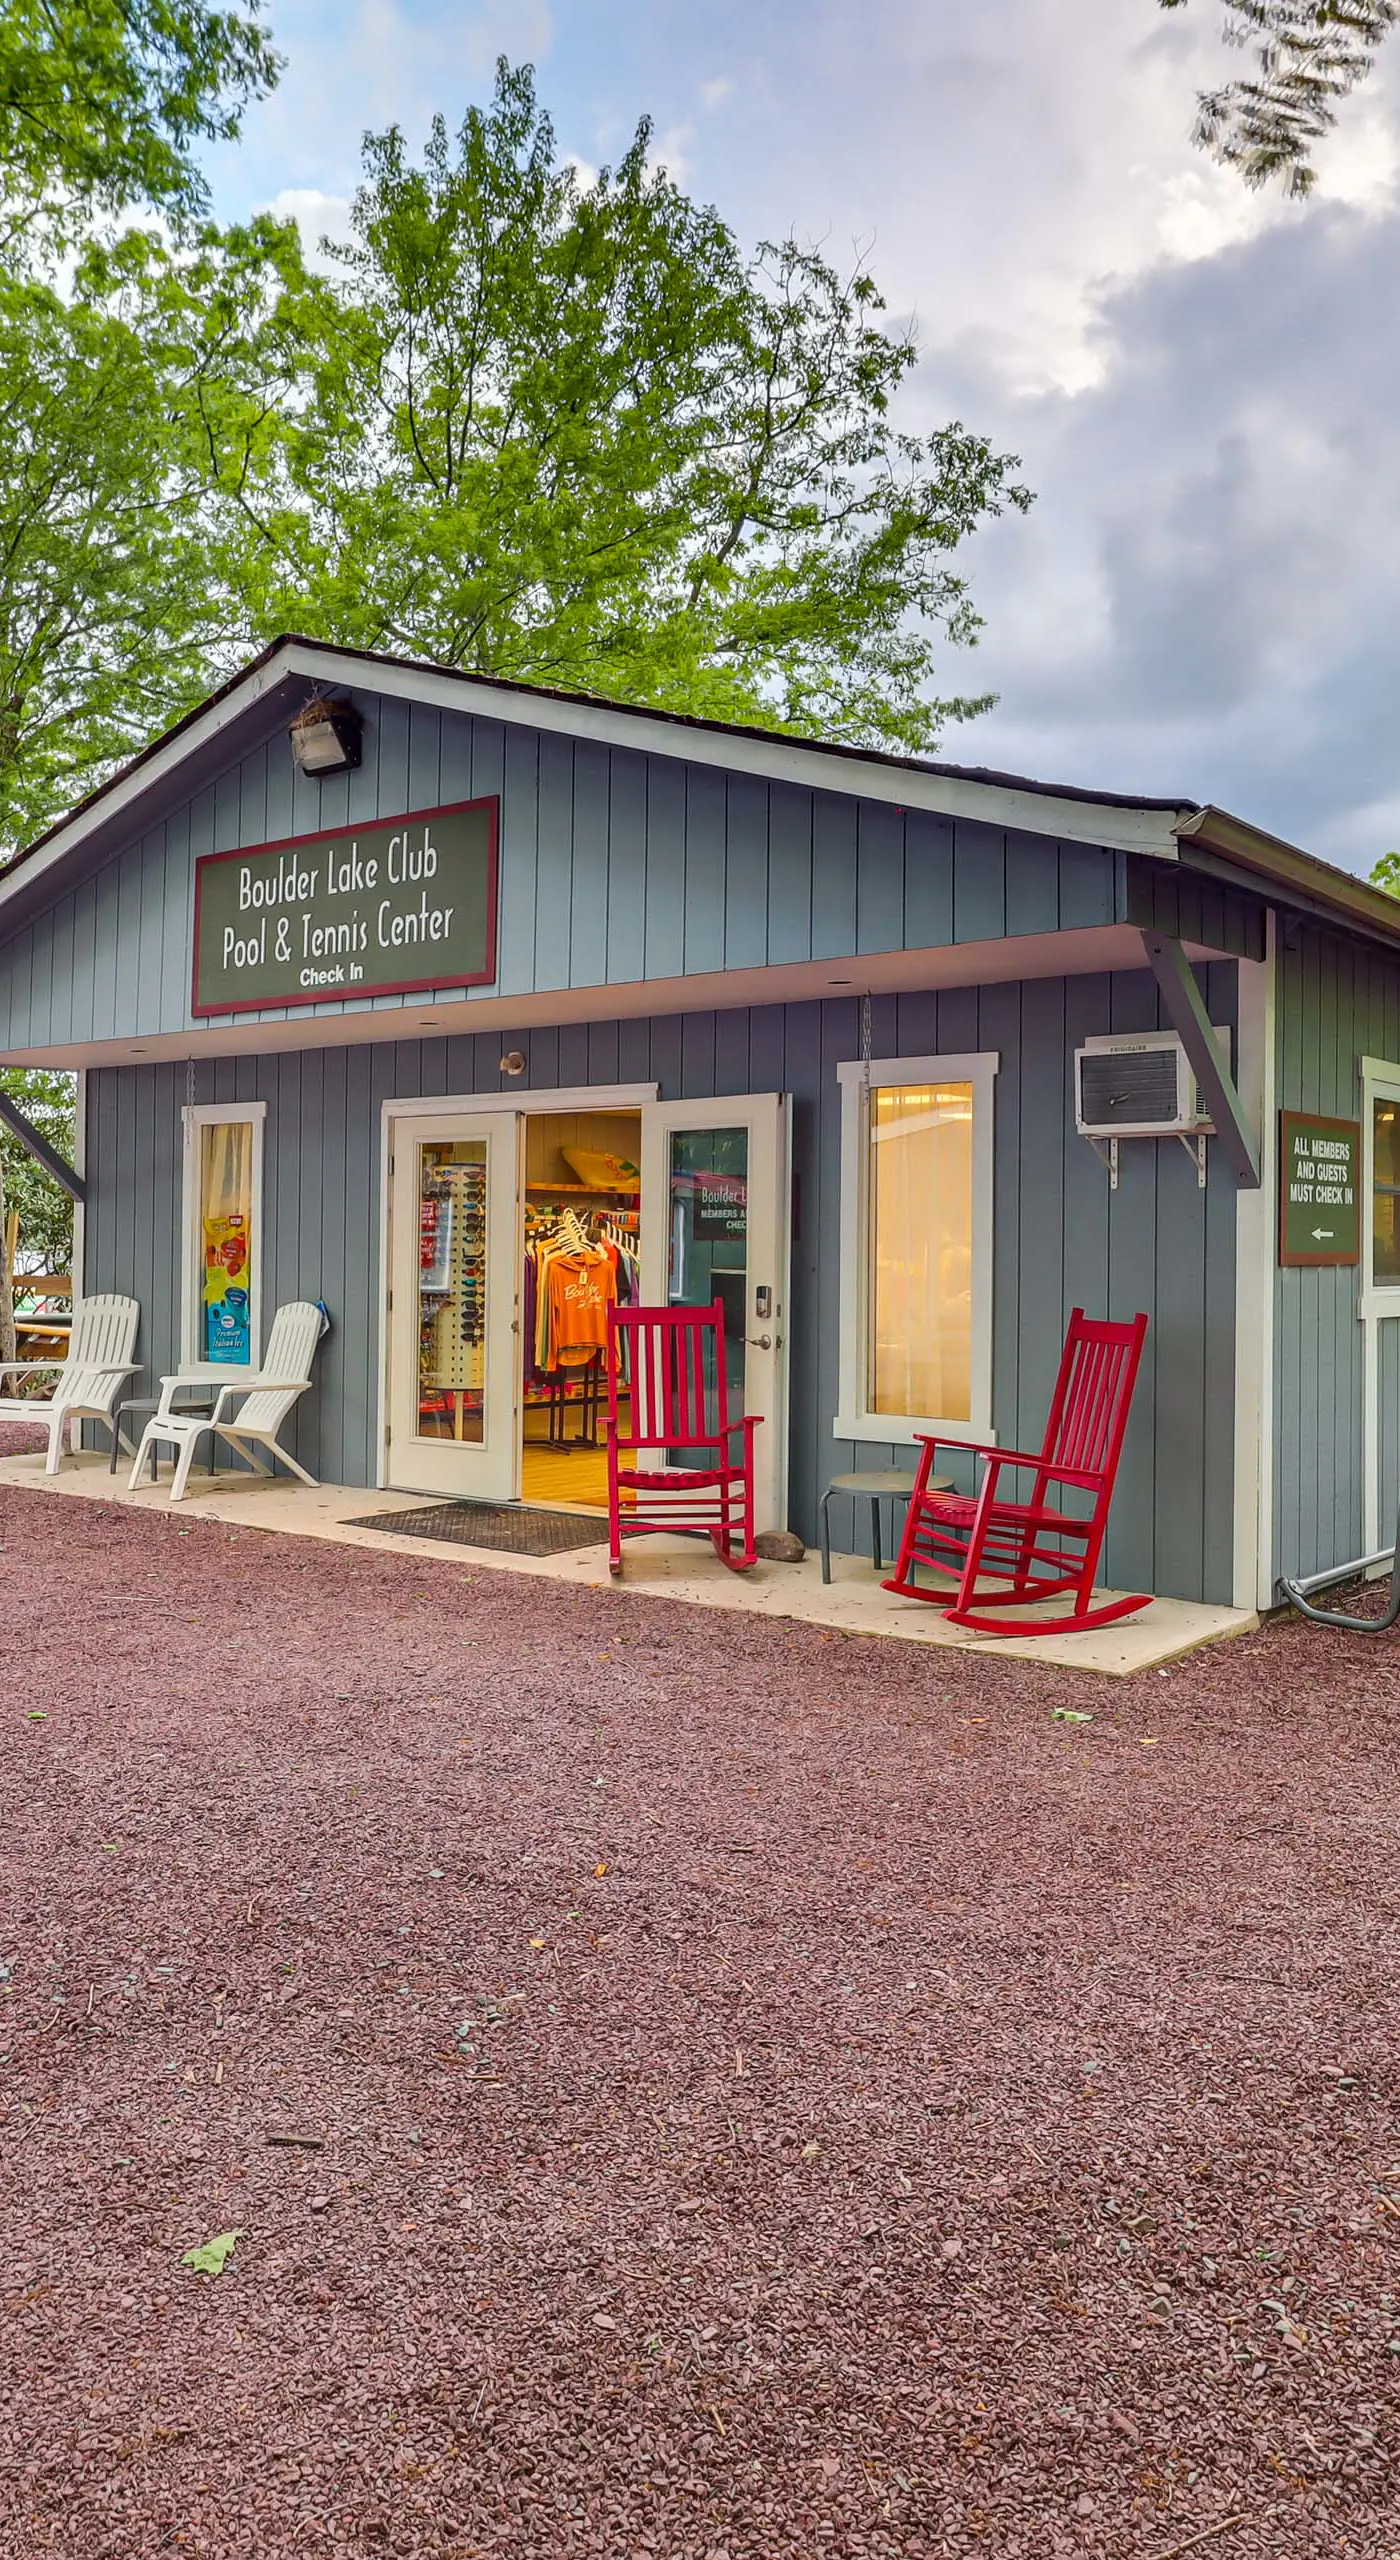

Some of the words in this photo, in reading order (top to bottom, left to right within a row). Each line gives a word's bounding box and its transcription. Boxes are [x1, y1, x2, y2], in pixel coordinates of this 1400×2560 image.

[239, 853, 319, 911] Boulder
[327, 842, 378, 895] Lake
[387, 827, 437, 884] Club
[223, 917, 266, 970] Pool
[274, 917, 292, 963] &
[302, 909, 368, 959] Tennis
[378, 891, 454, 948] Center
[300, 963, 344, 987] Check
[349, 962, 364, 981] In
[1293, 1136, 1310, 1156] ALL
[1311, 1139, 1350, 1161] MEMBERS
[1296, 1160, 1315, 1180] AND
[1316, 1163, 1348, 1183] GUESTS
[702, 1185, 737, 1203] Boulder
[1290, 1183, 1314, 1203] MUST
[1315, 1185, 1343, 1205] CHECK
[1344, 1187, 1353, 1205] IN
[701, 1209, 737, 1218] MEMBERS
[726, 1220, 747, 1229] CHEC
